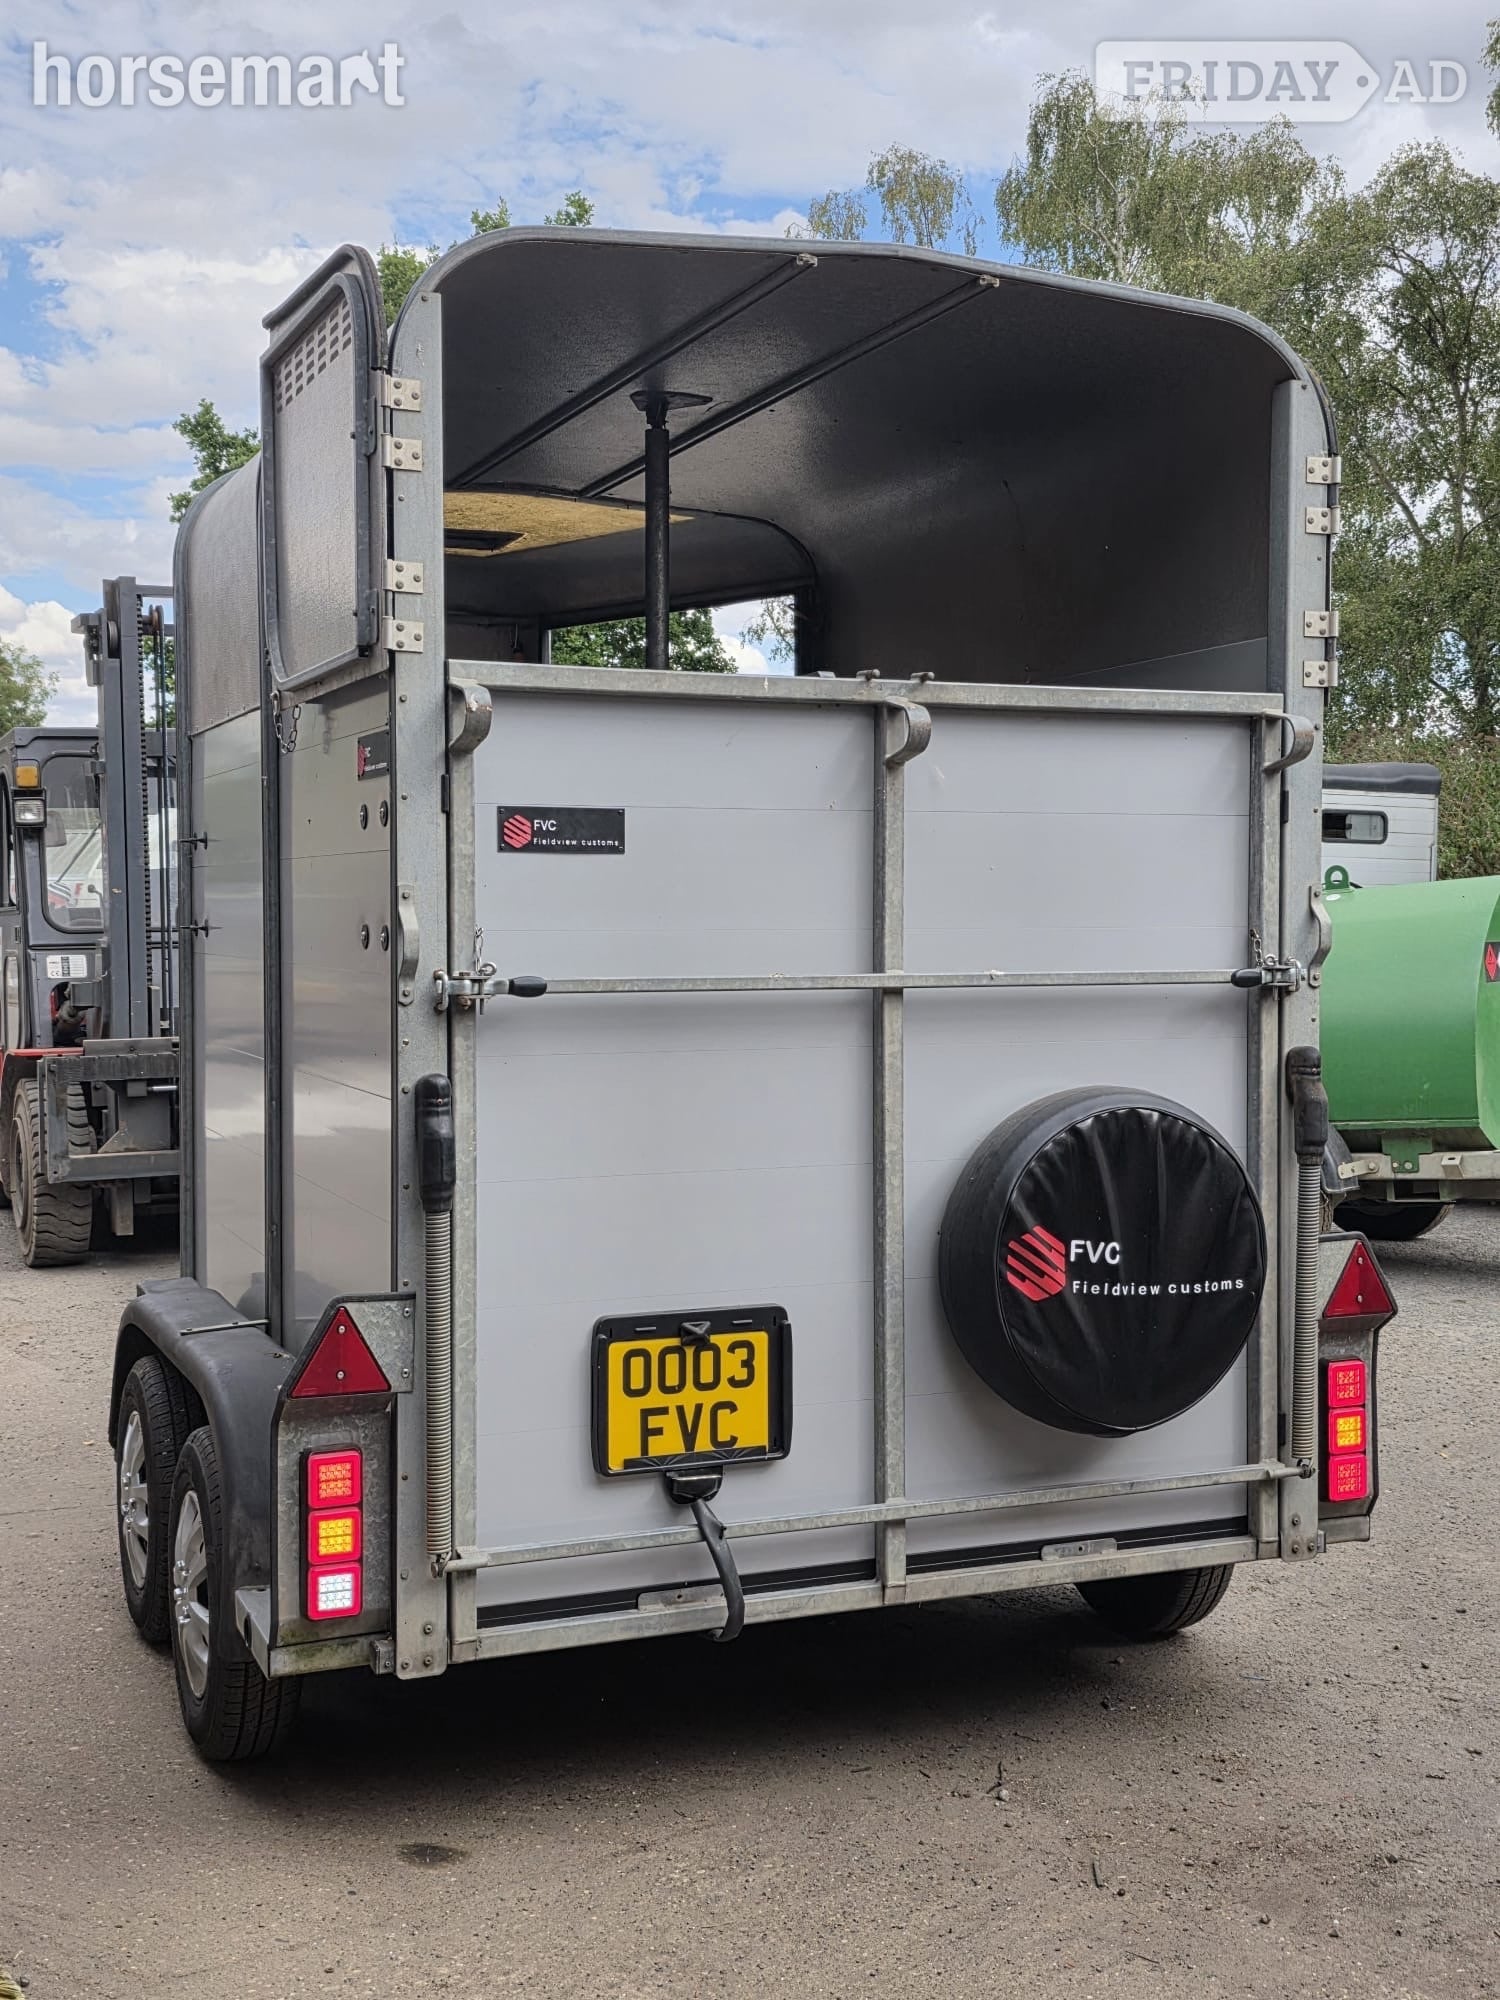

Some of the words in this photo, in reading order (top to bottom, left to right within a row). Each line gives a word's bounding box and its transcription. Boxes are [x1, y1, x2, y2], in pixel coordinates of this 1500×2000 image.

[533, 820, 557, 831] FVC
[533, 838, 578, 846] Fieldview
[581, 839, 619, 847] customs
[1069, 1239, 1120, 1265] FVC
[1072, 1280, 1161, 1296] Fieldview
[1168, 1279, 1245, 1294] customs
[639, 1400, 739, 1458] FVC
